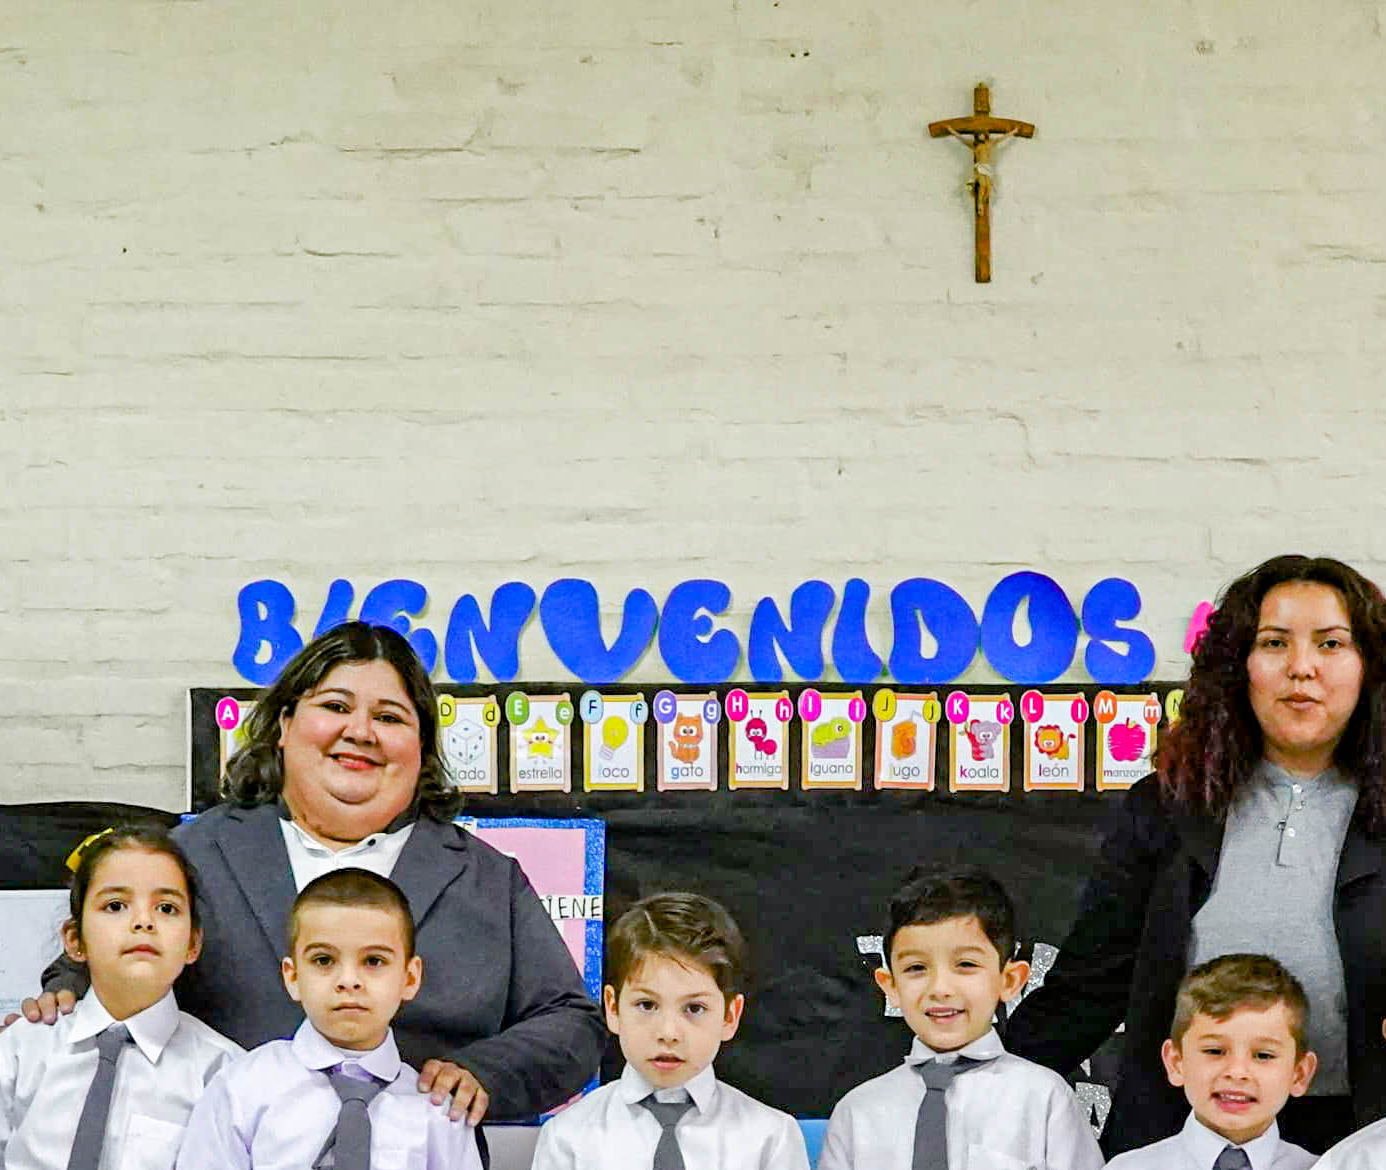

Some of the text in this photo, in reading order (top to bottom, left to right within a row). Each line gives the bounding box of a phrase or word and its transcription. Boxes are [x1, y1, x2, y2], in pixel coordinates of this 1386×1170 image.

[232, 570, 1156, 686] BIENVENIDOS
[441, 703, 495, 722] D d
[513, 699, 570, 719] E e
[588, 700, 598, 714] F
[659, 698, 716, 720] G g
[732, 697, 789, 718] H h
[952, 699, 1011, 719] K k
[1098, 700, 1160, 718] M m
[518, 765, 563, 780] estrella
[671, 765, 703, 780] gato
[735, 762, 781, 777] hormiga
[810, 761, 853, 777] iguana
[959, 764, 999, 779] koala
[1038, 762, 1069, 778] león
[539, 895, 603, 919] IENE
